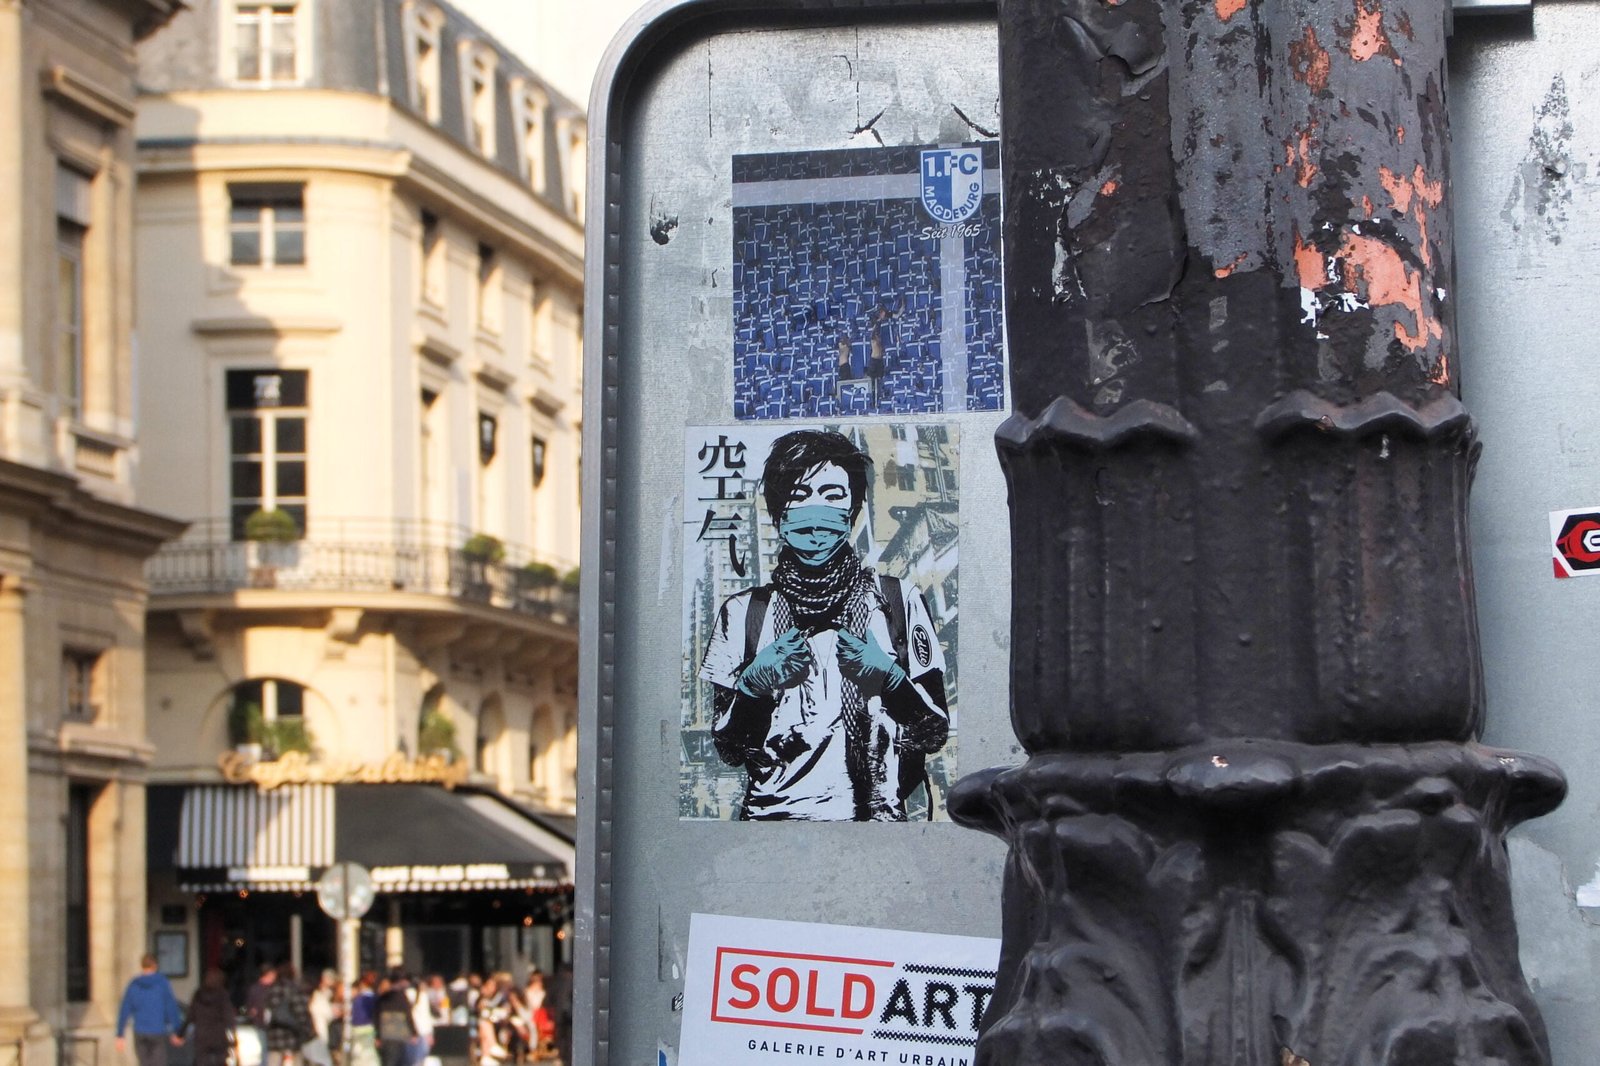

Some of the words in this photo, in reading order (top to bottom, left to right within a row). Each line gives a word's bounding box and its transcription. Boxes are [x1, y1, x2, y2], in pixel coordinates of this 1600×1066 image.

[924, 182, 980, 220] MAGDEBURG
[920, 227, 948, 240] Seit
[950, 223, 981, 238] 1965
[696, 435, 746, 577] 空气
[748, 1039, 825, 1056] GALERIE
[836, 1047, 888, 1061] D'ART
